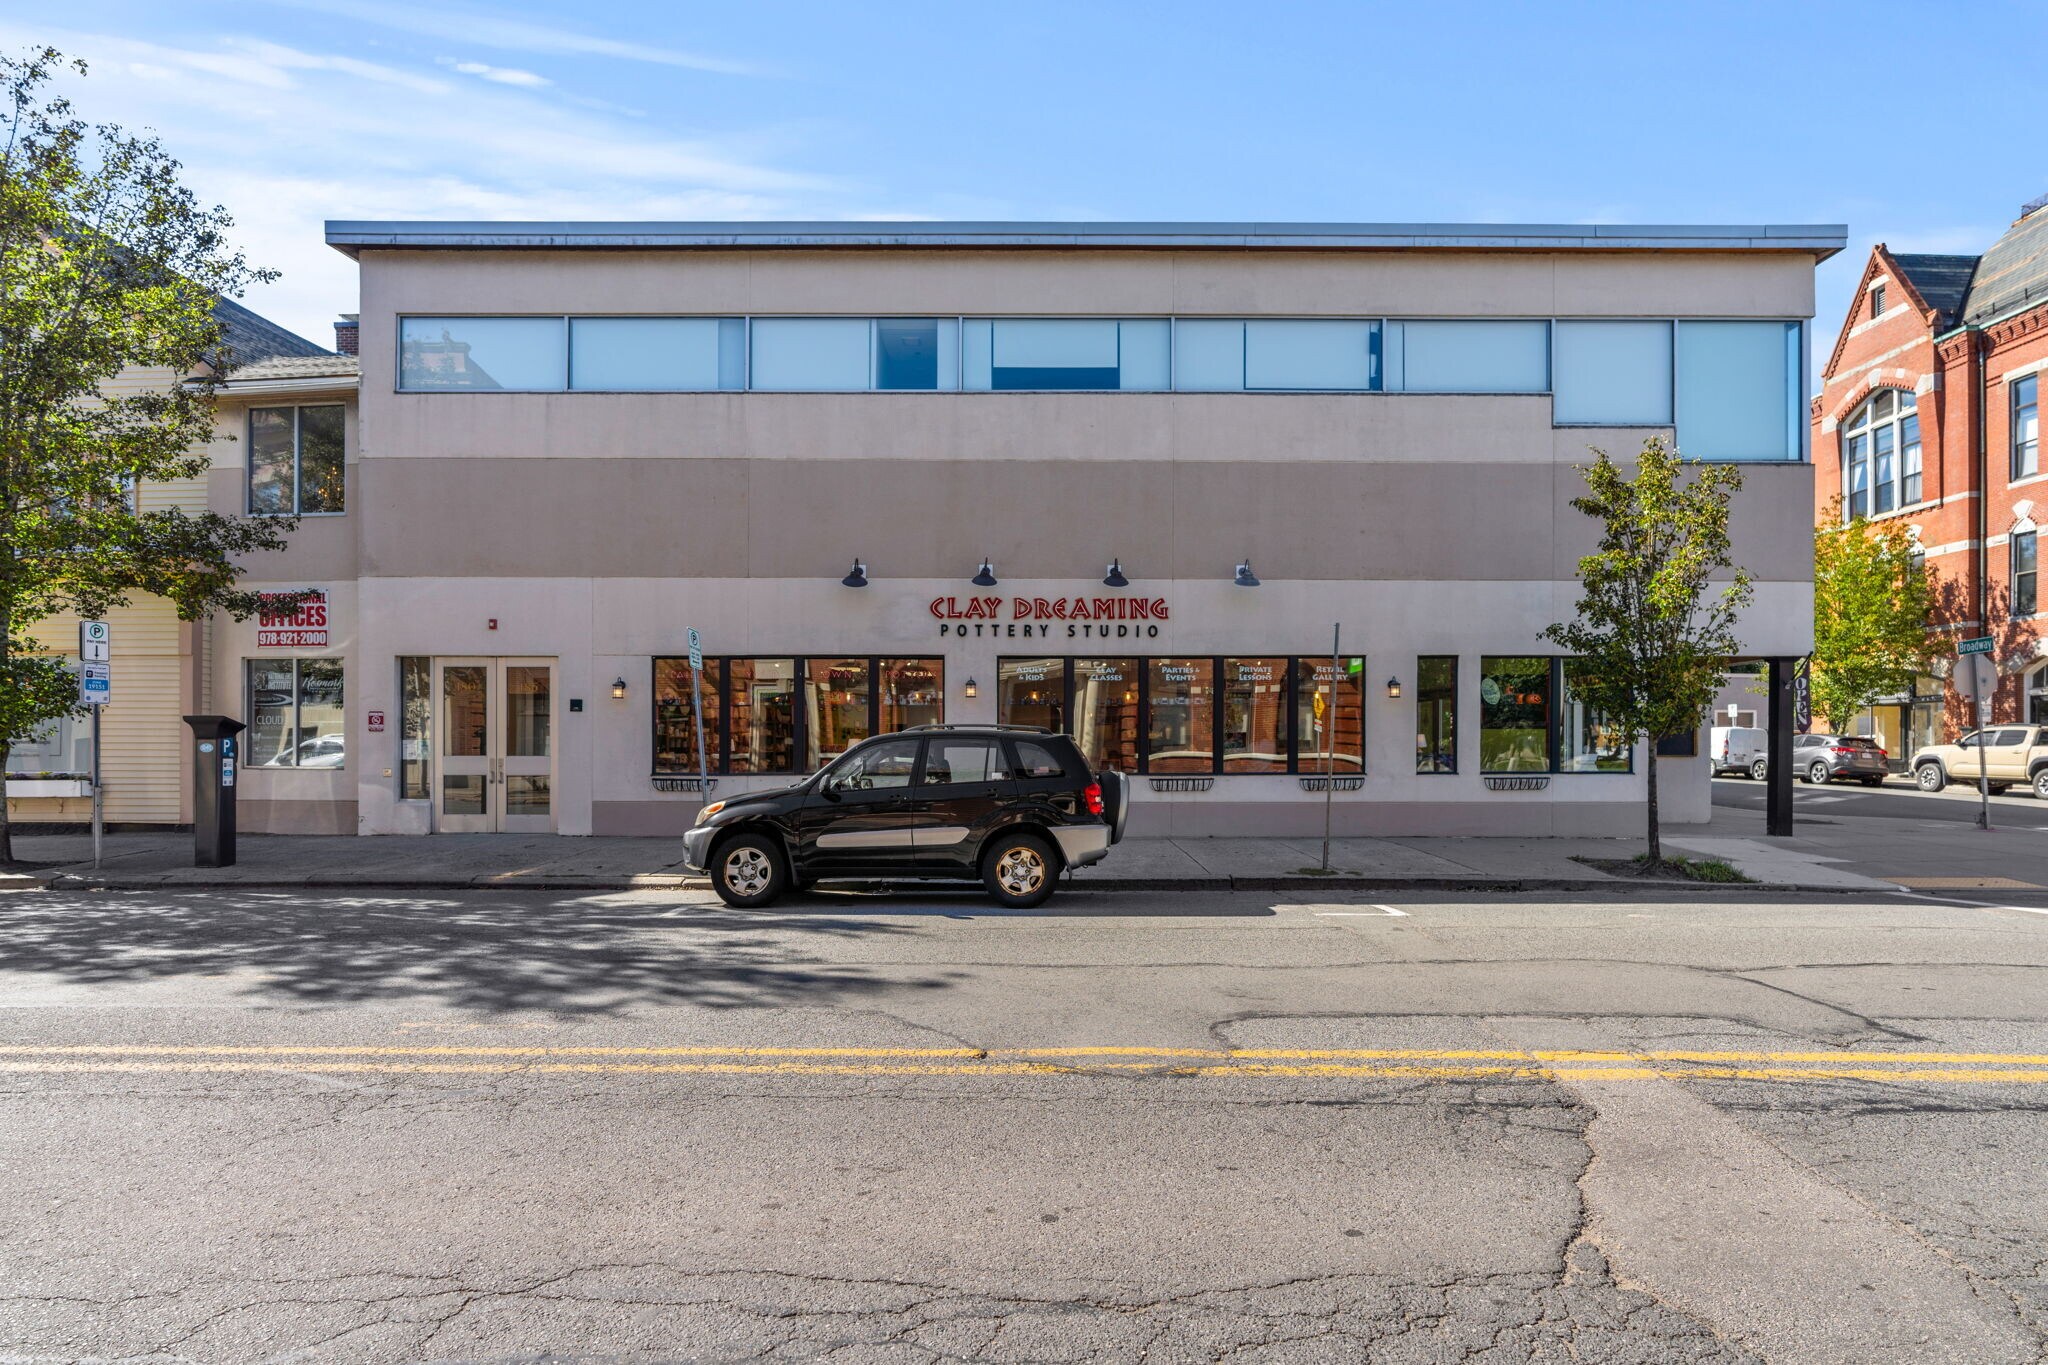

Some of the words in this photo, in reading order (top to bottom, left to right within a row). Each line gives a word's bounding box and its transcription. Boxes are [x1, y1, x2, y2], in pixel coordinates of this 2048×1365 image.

[930, 597, 1003, 620] CLAY
[1013, 597, 1169, 620] DREAMING
[940, 624, 1049, 637] POTTERY
[1067, 624, 1159, 638] STUDIO
[1959, 640, 1992, 653] Broadway
[1161, 666, 1194, 674] PARTIES
[1312, 673, 1349, 681] GALLRY
[256, 715, 284, 725] CLOUD
[223, 739, 231, 753] P
